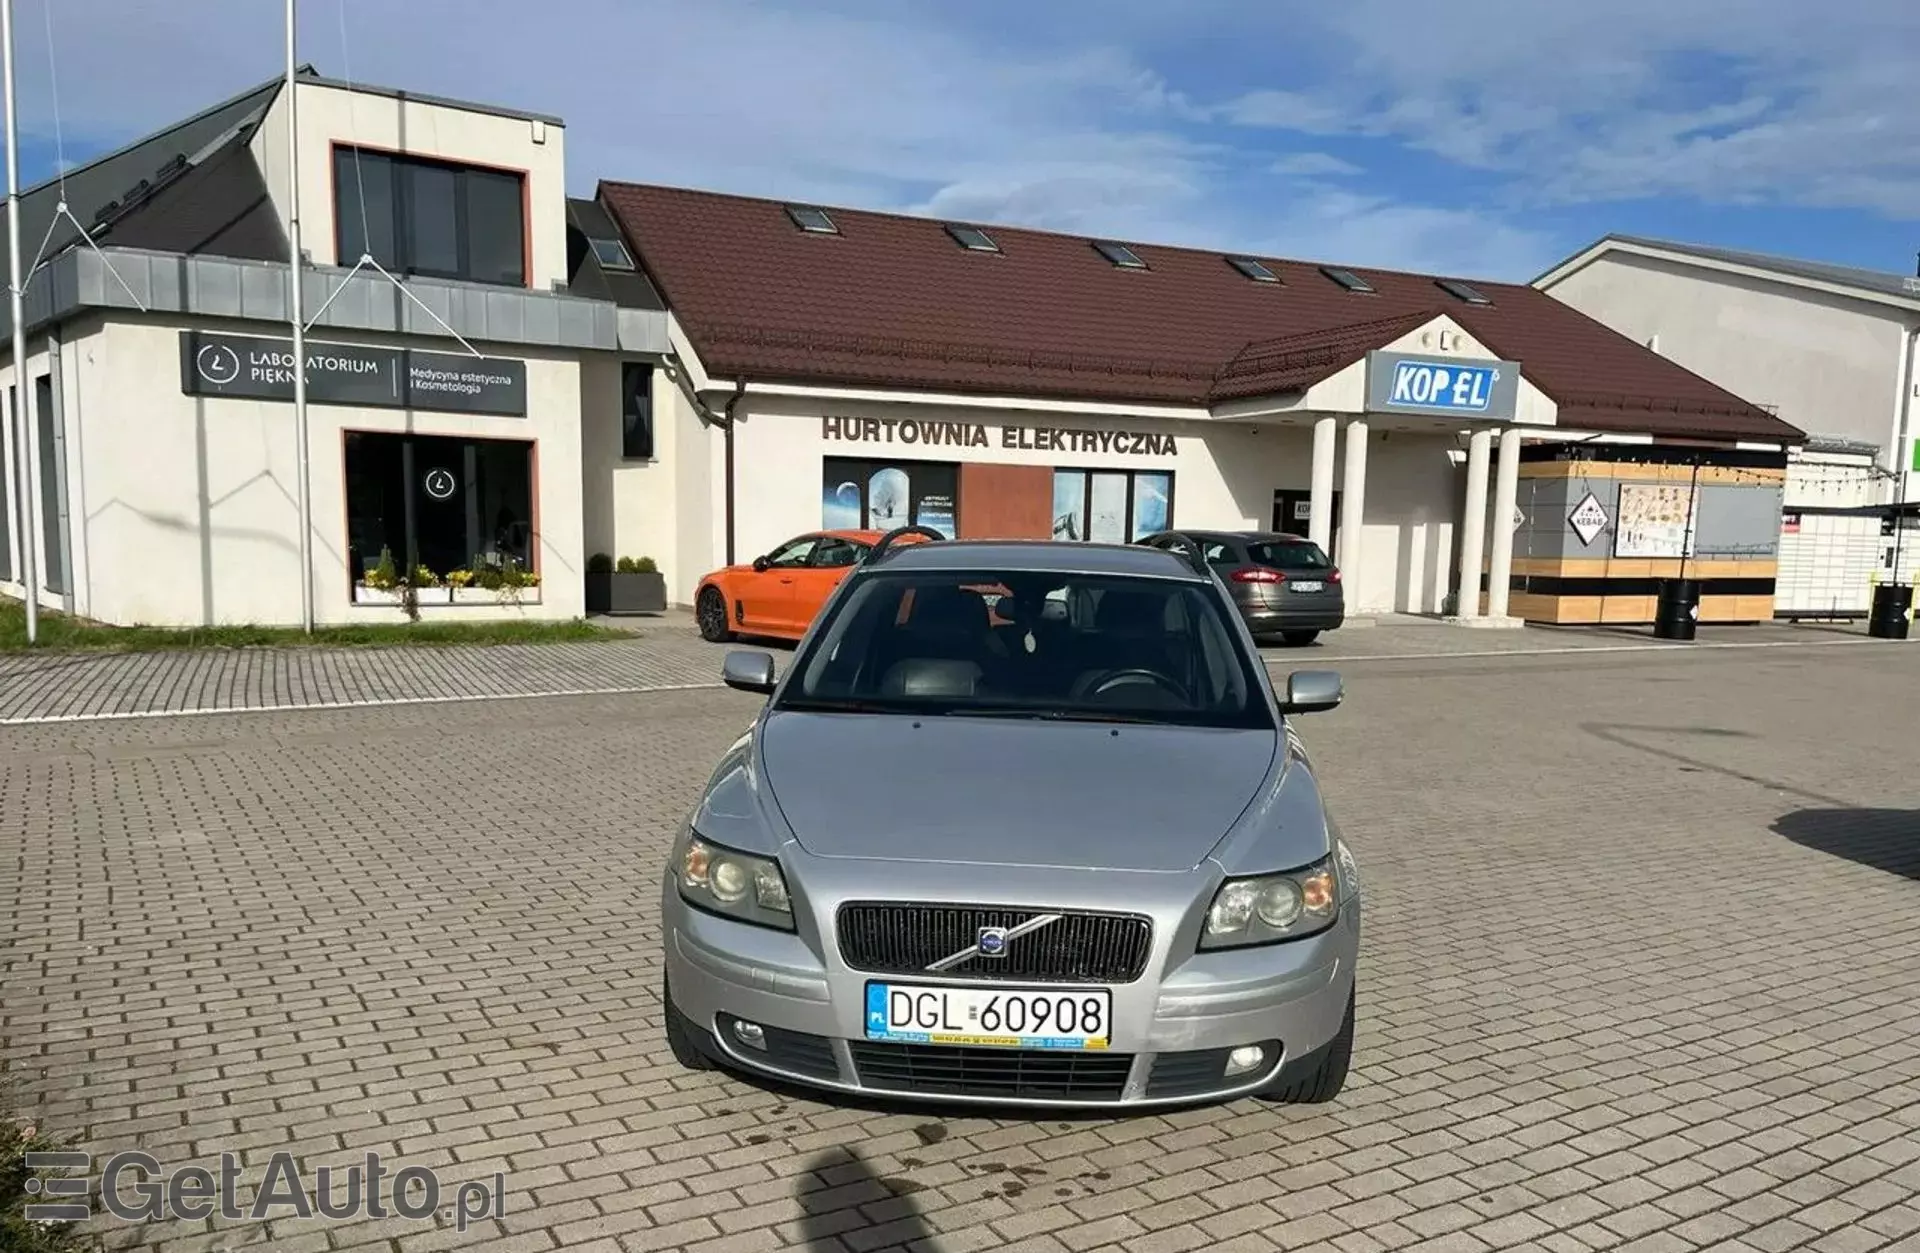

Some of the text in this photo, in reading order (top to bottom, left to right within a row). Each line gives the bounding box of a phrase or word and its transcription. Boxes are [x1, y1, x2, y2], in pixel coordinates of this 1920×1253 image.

[250, 351, 378, 374] LABOATORIUM
[251, 367, 309, 385] PIĘKN
[410, 367, 512, 385] Medycyna estetyczna
[416, 379, 481, 394] Kosmetologia
[822, 415, 1178, 456] HURTOWNIA ELEKTRYCZNA
[871, 1011, 886, 1024] PL
[890, 991, 1102, 1034] DGL 60908
